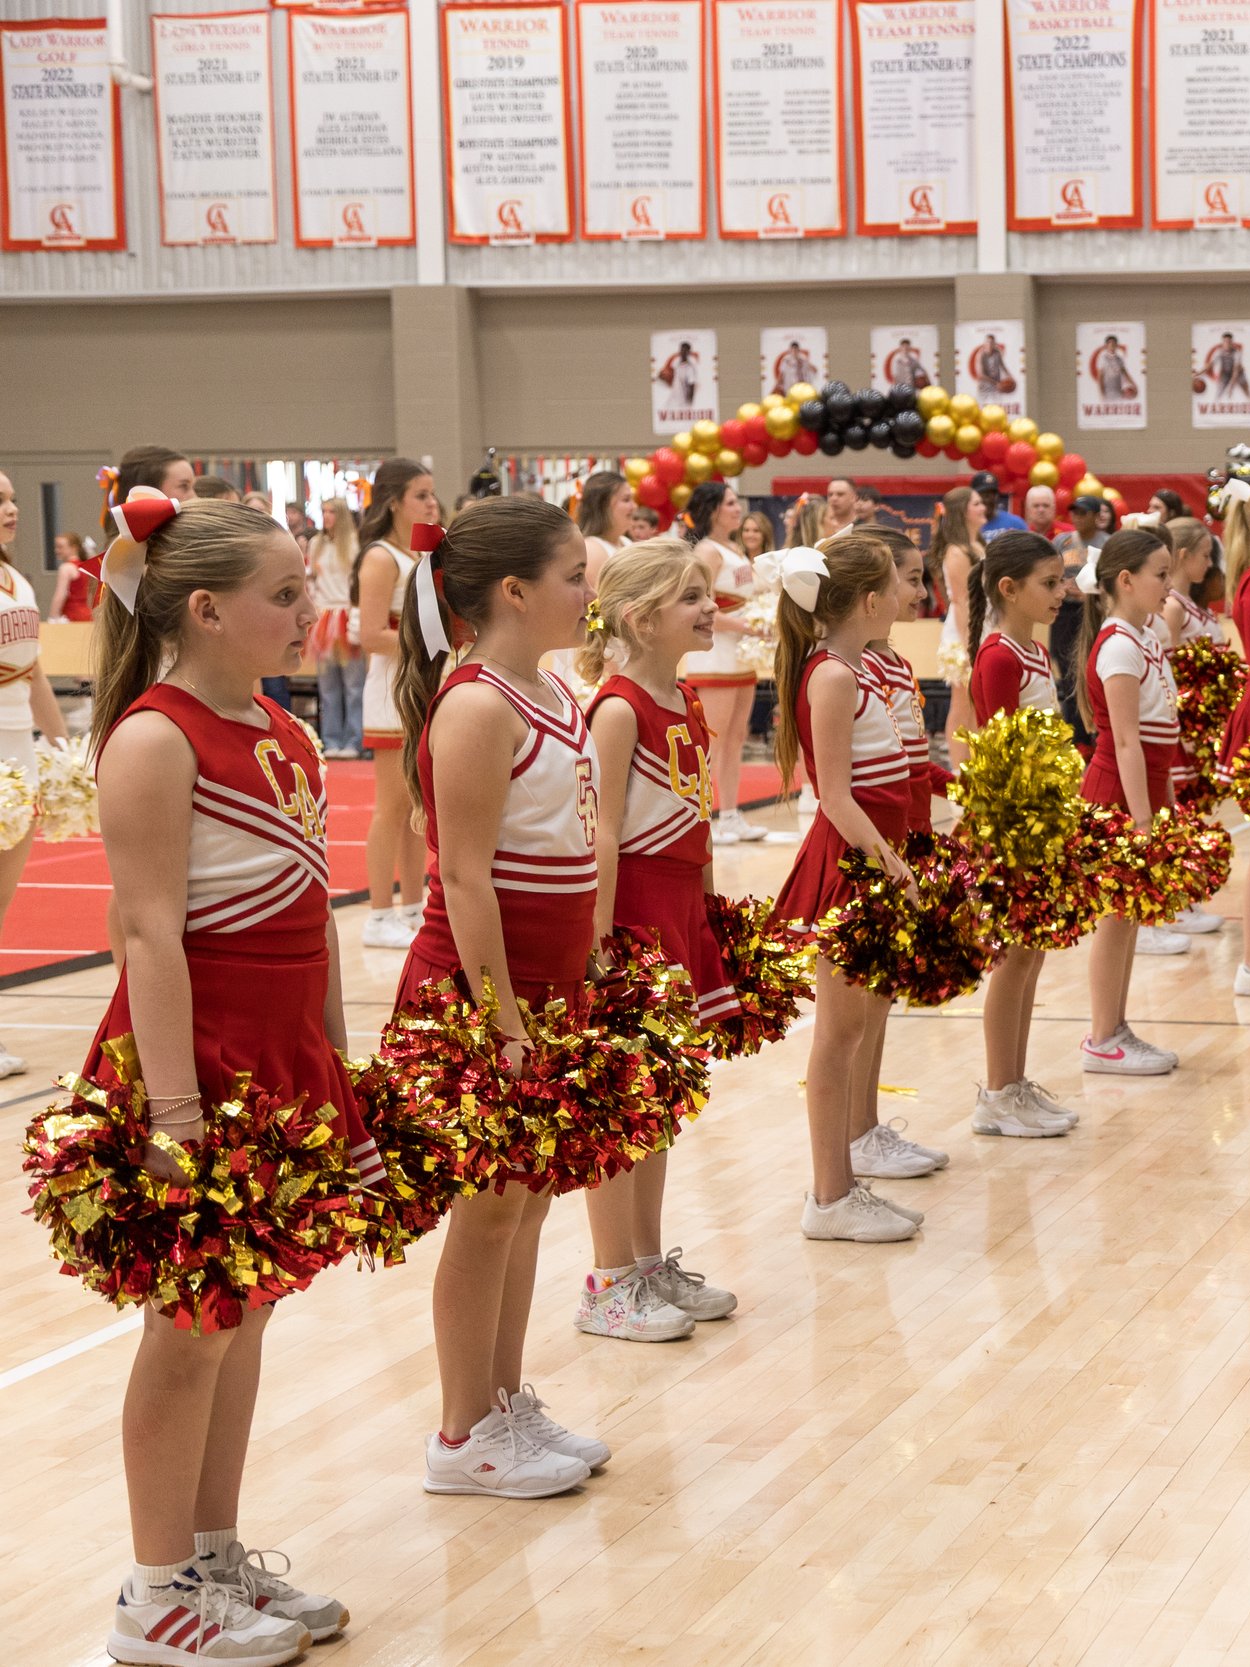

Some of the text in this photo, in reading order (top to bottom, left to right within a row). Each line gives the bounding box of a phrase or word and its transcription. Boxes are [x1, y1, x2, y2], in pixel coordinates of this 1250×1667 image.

[882, 5, 959, 21] WARRIOR
[1030, 0, 1112, 13] WARRIOR
[600, 11, 681, 25] WARRIOR
[736, 8, 818, 22] WARRIOR
[460, 18, 549, 34] WARRIOR
[866, 22, 976, 38] TEAM TENNIS
[1028, 18, 1115, 30] BASKETBALL
[46, 33, 105, 47] WARRIOR
[1053, 35, 1091, 50] 2022
[1201, 29, 1235, 43] 2021
[624, 46, 659, 60] 2020
[761, 43, 794, 57] 2021
[903, 41, 940, 57] 2022
[1169, 45, 1201, 56] STATE
[37, 51, 77, 63] GOLF
[335, 57, 366, 71] 2021
[486, 56, 525, 70] 2019
[730, 56, 826, 71] STATE CHAMPIONS
[1017, 52, 1127, 71] STATE CHAMPIONS
[197, 58, 229, 71] 2021
[594, 59, 689, 74] STATE CHAMPIONS
[870, 59, 904, 74] STATE
[41, 67, 73, 81] 2022
[164, 71, 197, 85] STATE
[303, 71, 336, 84] STATE
[11, 84, 42, 99] STATE
[658, 408, 715, 422] WARRIOR
[1082, 403, 1143, 417] WARRIOR
[666, 723, 714, 823] CA
[254, 738, 325, 842] CA
